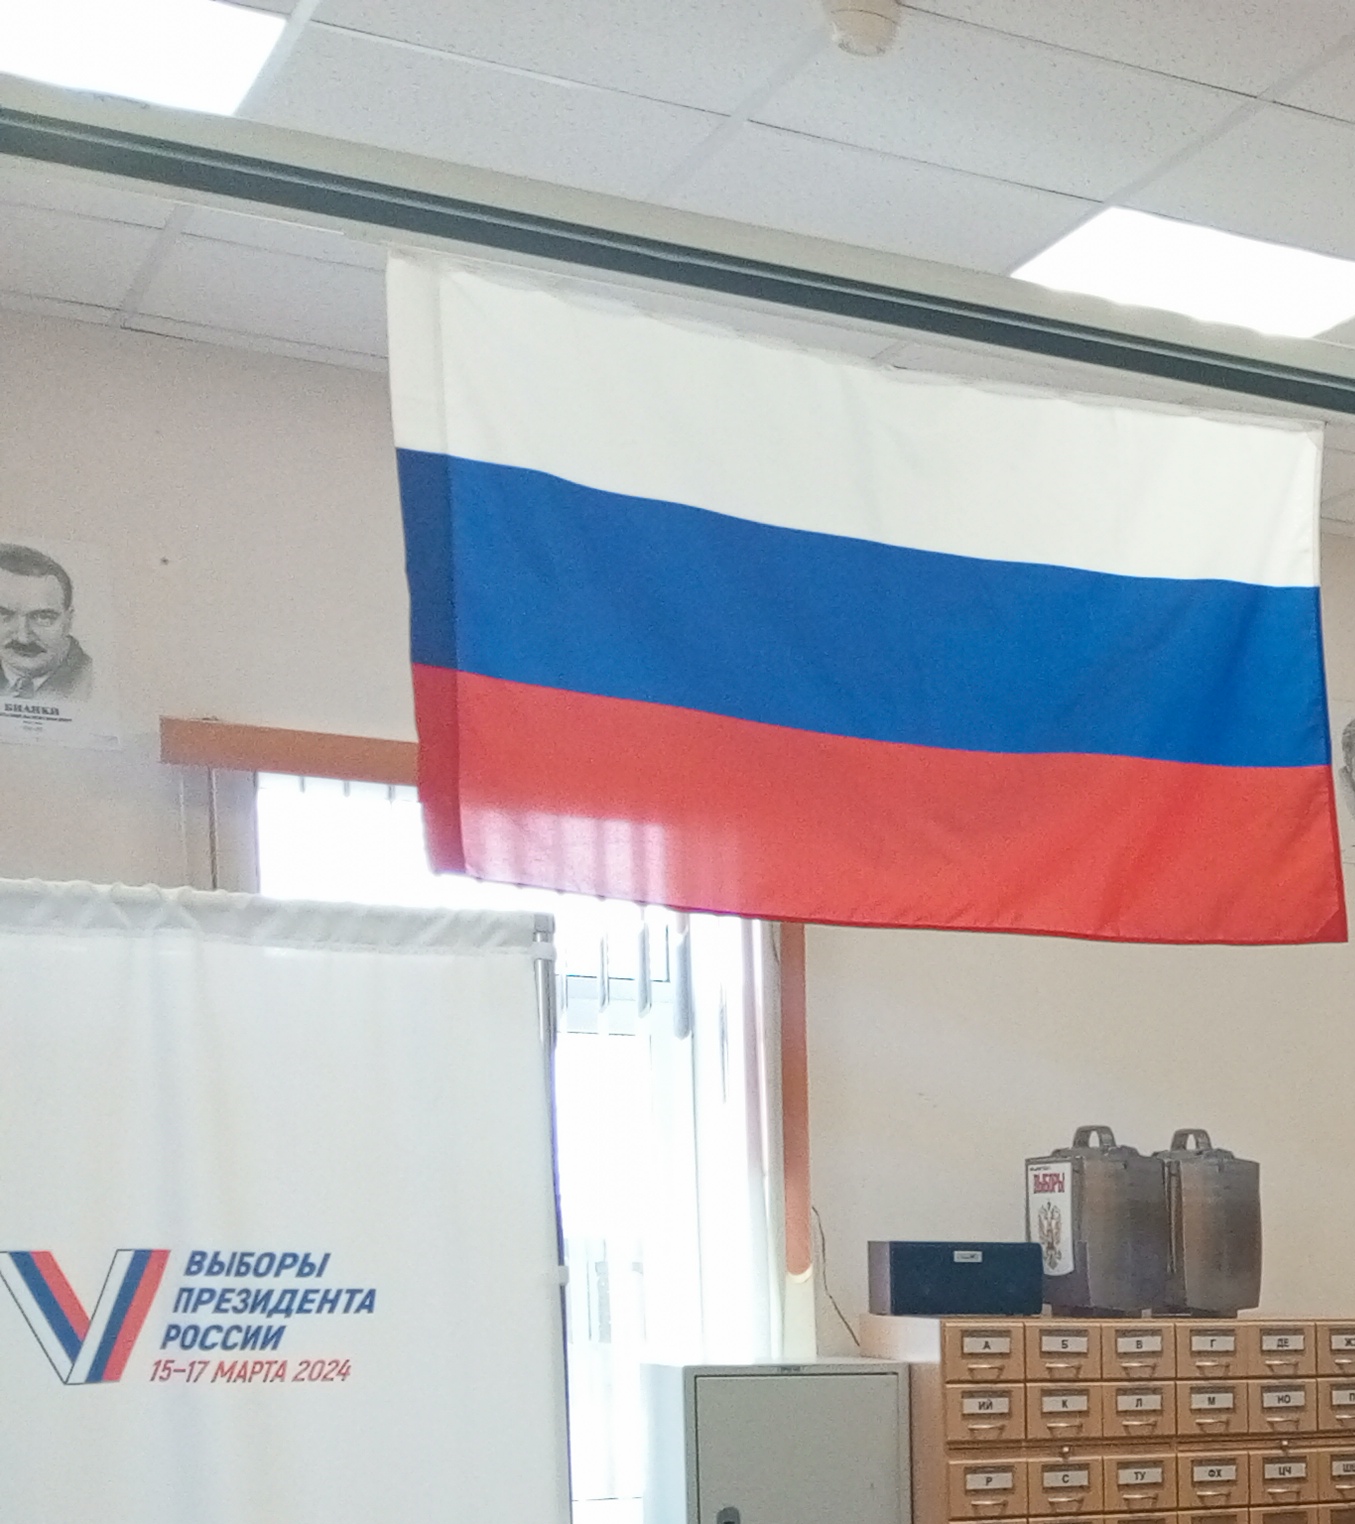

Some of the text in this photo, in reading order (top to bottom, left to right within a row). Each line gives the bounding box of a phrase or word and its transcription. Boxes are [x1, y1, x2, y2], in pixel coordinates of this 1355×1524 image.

[184, 1251, 332, 1278] ВЫБОРЫ
[172, 1287, 377, 1316] ПРЕЗИДЕНТА
[160, 1324, 286, 1351] РОССИИ
[1210, 1338, 1216, 1348] Г
[1276, 1337, 1290, 1349] ДЕ
[982, 1340, 991, 1350] А
[1061, 1339, 1069, 1349] Б
[1136, 1339, 1142, 1349] В
[210, 1360, 288, 1383] МАРТА
[292, 1360, 352, 1383] 2024
[1134, 1397, 1143, 1407] Л
[1207, 1396, 1216, 1406] М
[1277, 1394, 1291, 1405] НО
[1349, 1392, 1355, 1402] П
[978, 1398, 994, 1411] ИЙ
[1062, 1398, 1068, 1409] К
[985, 1475, 993, 1486] Р
[1062, 1474, 1069, 1483] С
[1134, 1470, 1147, 1481] ТУ
